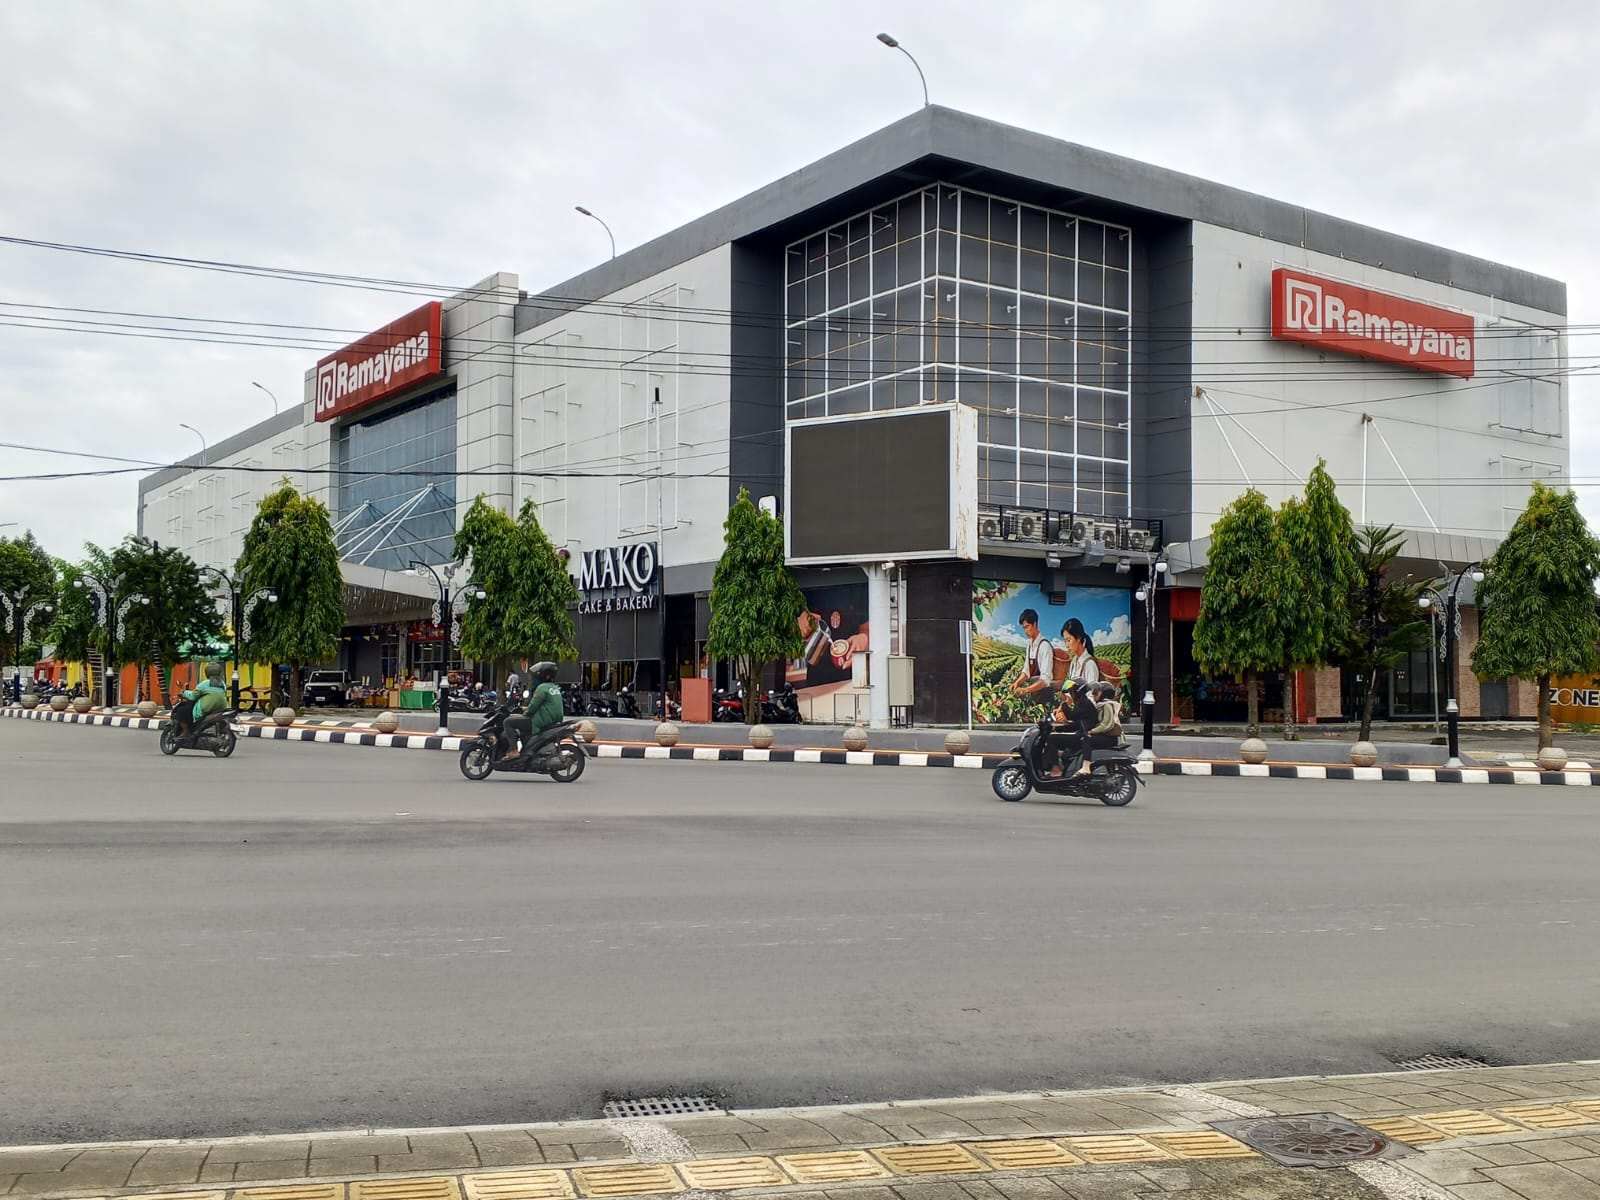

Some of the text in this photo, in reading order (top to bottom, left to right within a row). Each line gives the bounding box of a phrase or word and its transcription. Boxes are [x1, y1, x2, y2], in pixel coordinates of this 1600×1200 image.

[1325, 295, 1471, 361] Ramayana
[337, 330, 429, 399] Ramayana
[578, 542, 654, 592] MAKO
[578, 595, 654, 614] CAKE & BAKERY
[1549, 687, 1600, 707] ZONE
